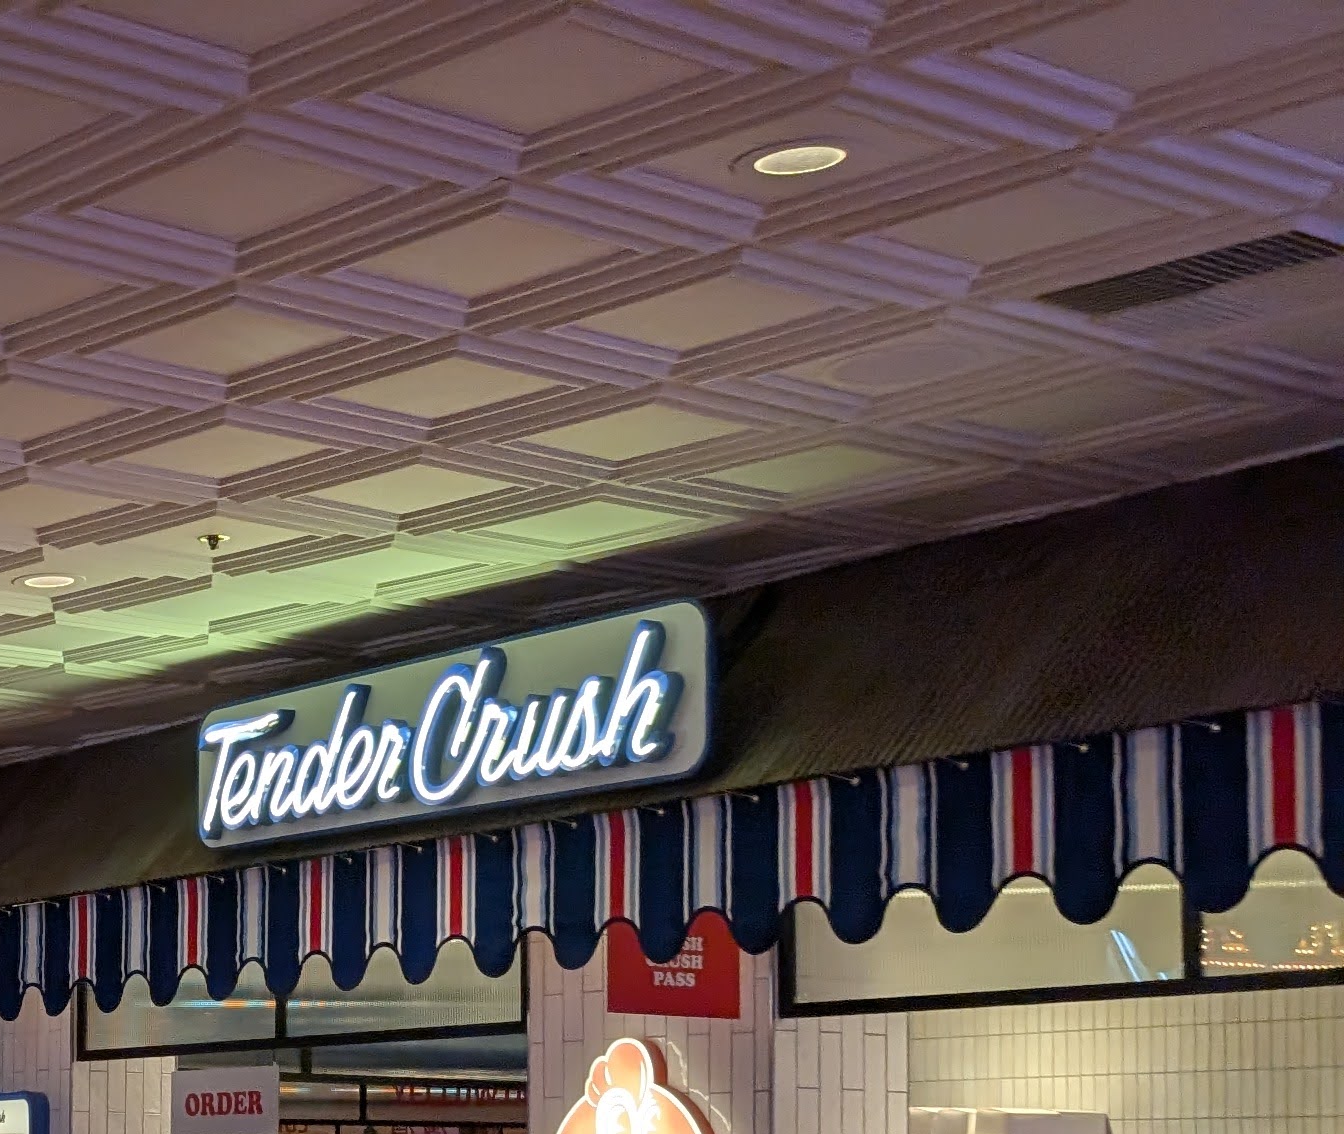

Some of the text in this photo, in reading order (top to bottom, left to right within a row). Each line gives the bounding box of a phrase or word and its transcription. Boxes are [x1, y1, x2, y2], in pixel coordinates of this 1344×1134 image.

[199, 618, 685, 840] Tender Crush
[653, 971, 696, 986] PASS
[185, 1091, 263, 1116] ORDER
